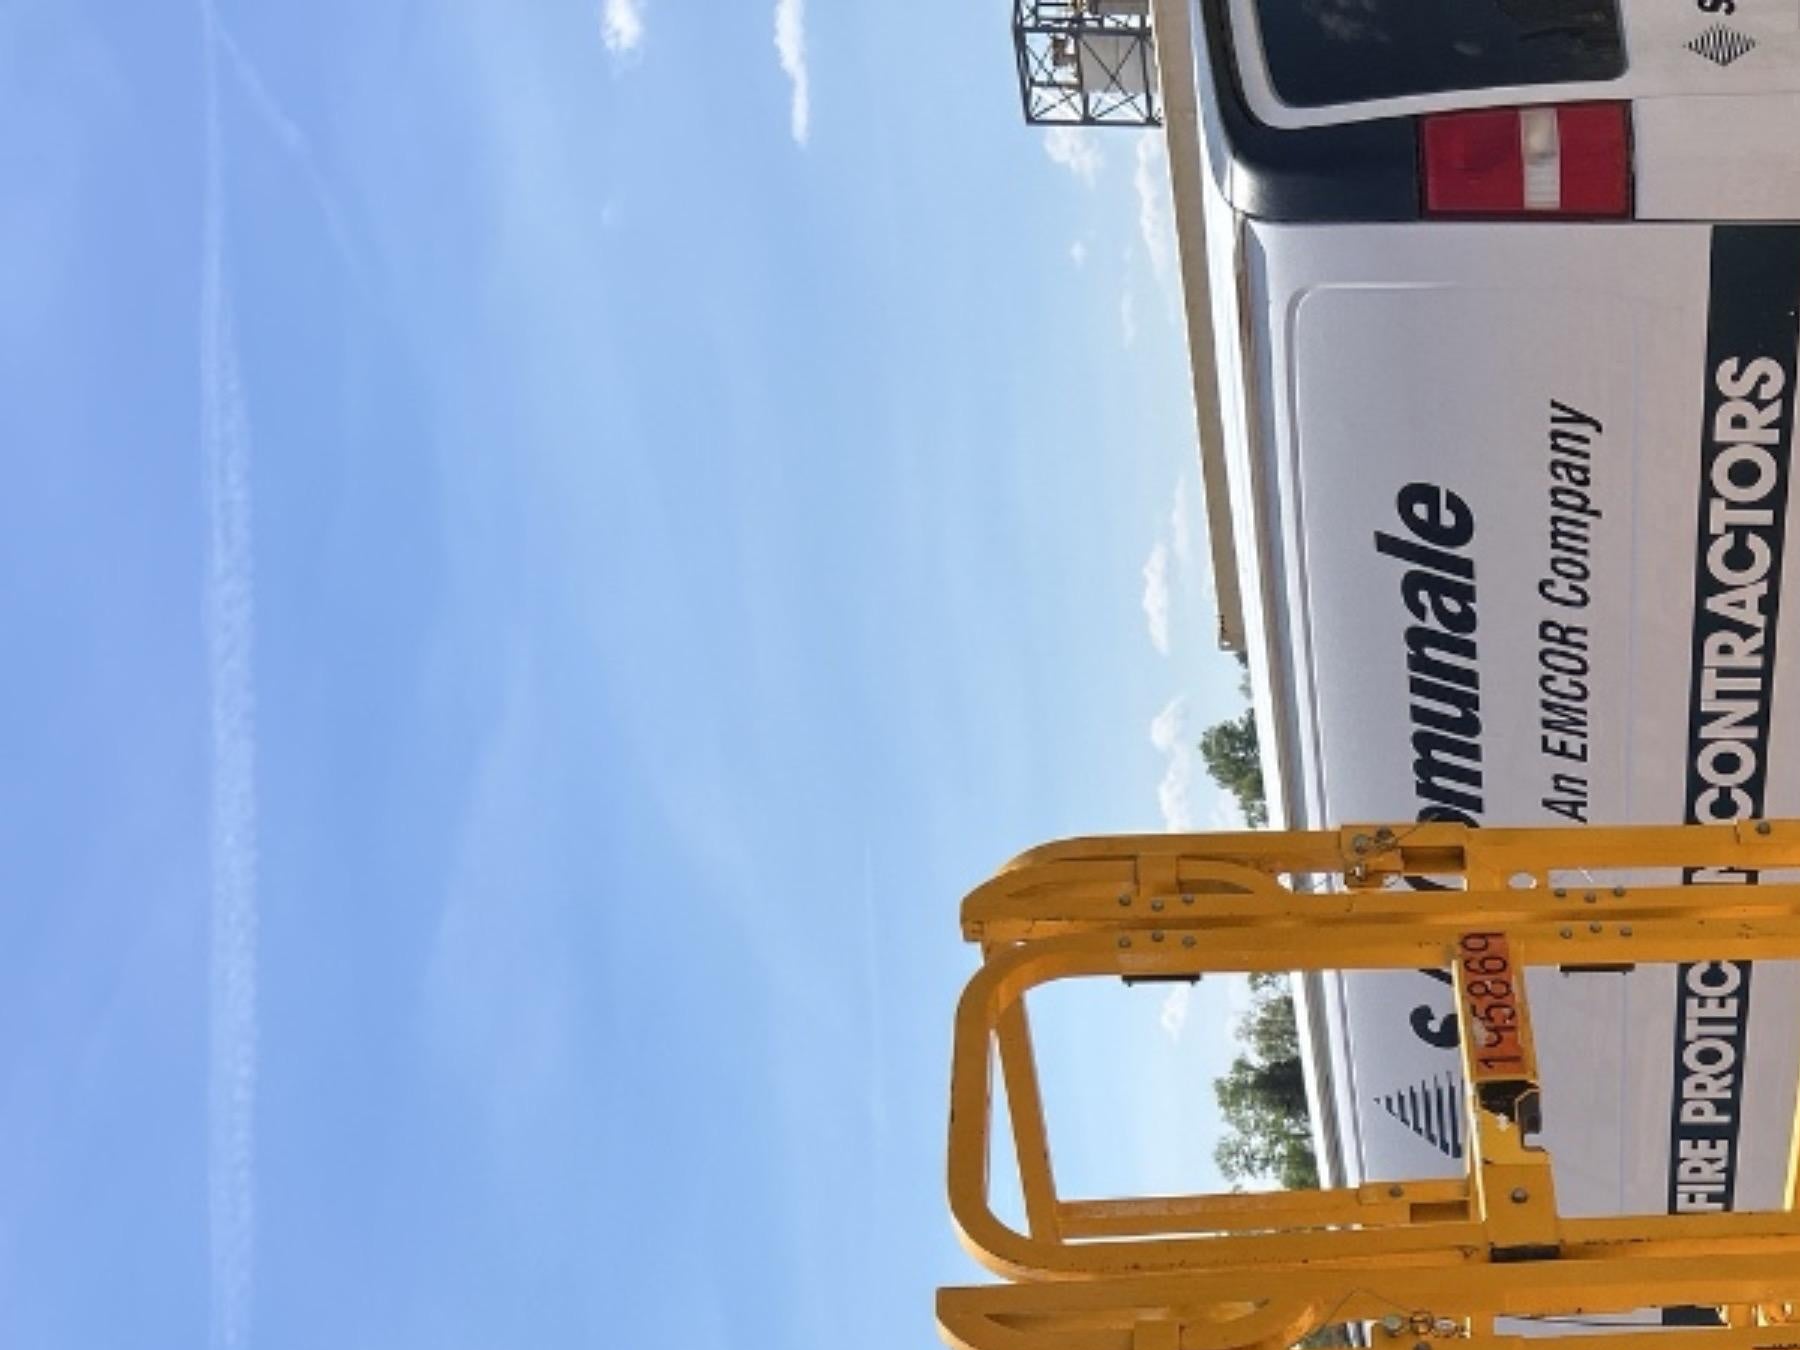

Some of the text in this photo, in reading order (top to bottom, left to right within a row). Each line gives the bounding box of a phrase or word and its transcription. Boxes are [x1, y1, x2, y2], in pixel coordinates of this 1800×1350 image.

[1374, 483, 1483, 891] munale
[1538, 400, 1602, 821] An EMCOR Company
[1695, 356, 1785, 823] CONTRACTORS
[1675, 1138, 1730, 1211] FIRE
